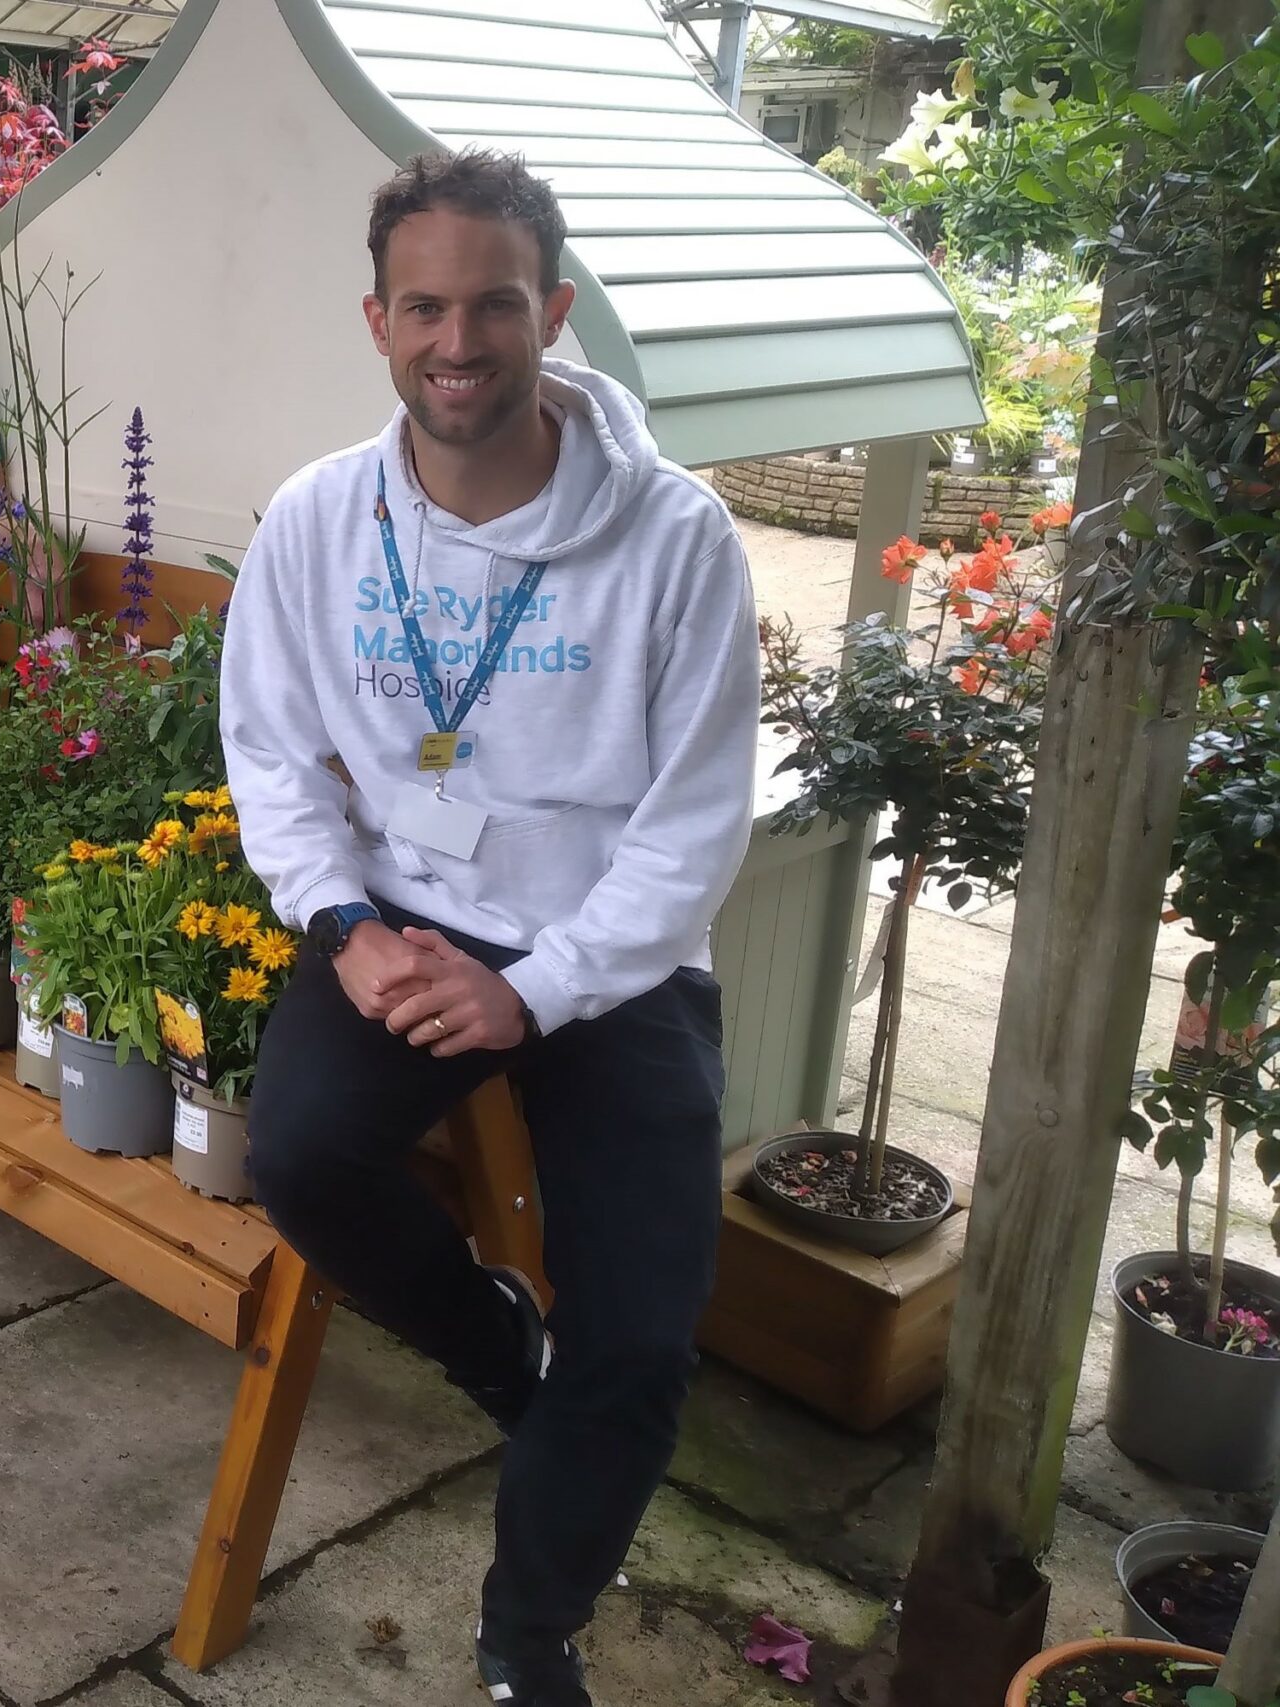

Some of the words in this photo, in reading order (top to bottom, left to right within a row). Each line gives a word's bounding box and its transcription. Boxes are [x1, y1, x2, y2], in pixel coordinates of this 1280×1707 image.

[355, 576, 429, 616] Sue
[434, 585, 557, 632] Ryder
[354, 624, 592, 673] Maorlnds
